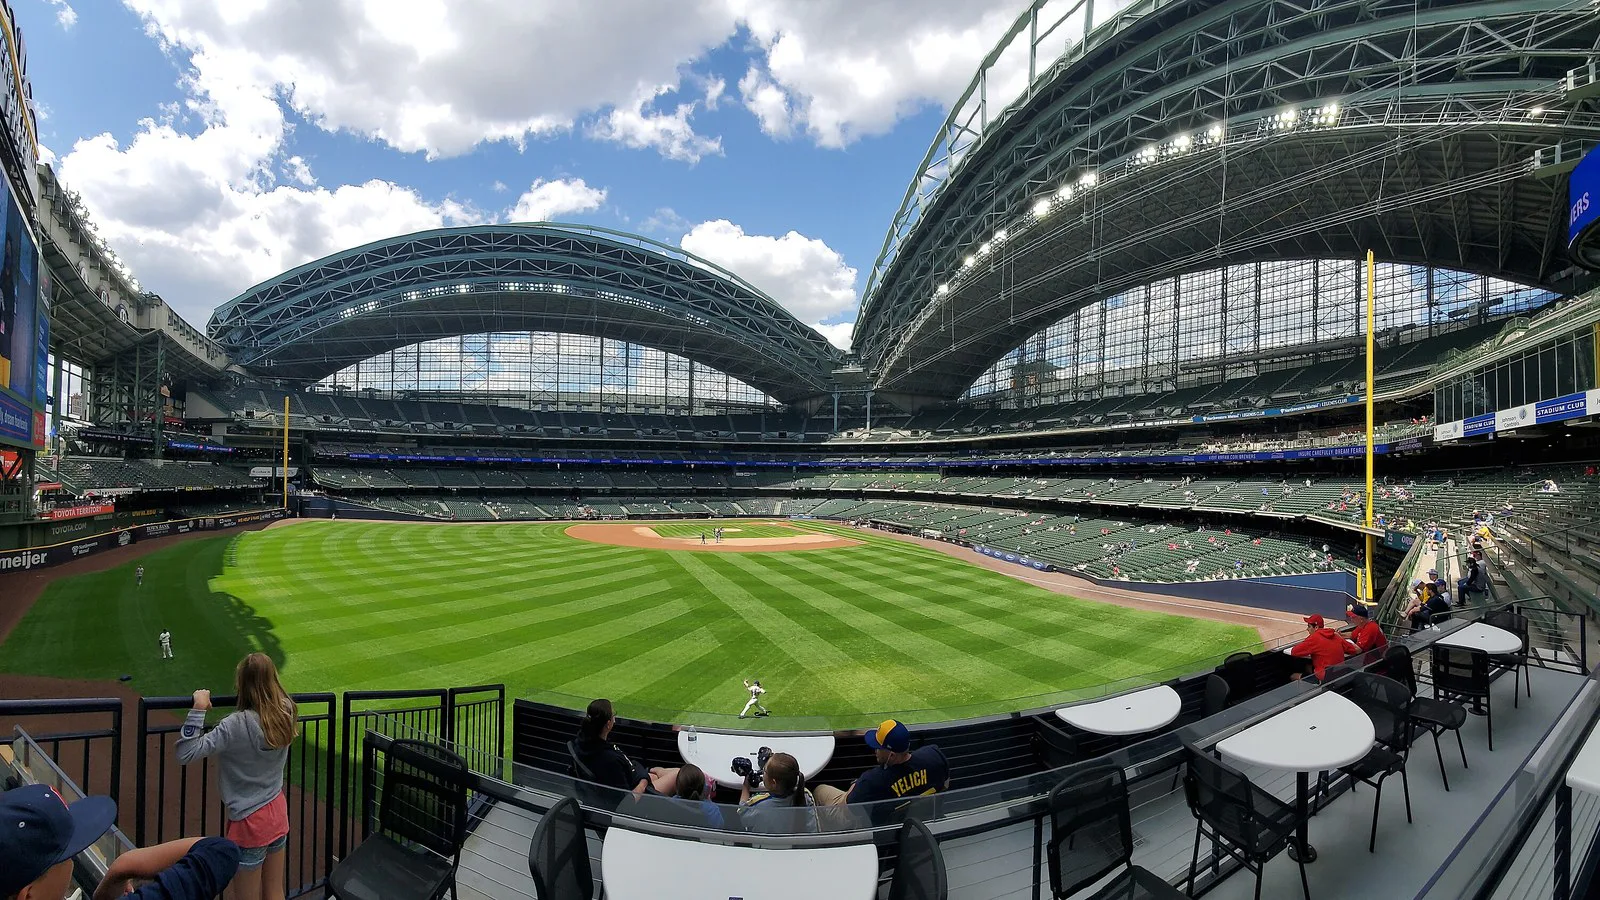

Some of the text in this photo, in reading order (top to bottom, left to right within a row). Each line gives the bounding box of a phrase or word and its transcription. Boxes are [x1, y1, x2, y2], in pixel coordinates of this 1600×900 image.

[1537, 402, 1585, 416] STADIUM CLUB
[1464, 423, 1482, 431] STADIUM
[1504, 421, 1520, 429] Controls
[53, 505, 102, 518] TOYOTA TERRITORY
[52, 522, 87, 535] TOYOTA.COM
[0, 551, 47, 569] meijer
[891, 768, 928, 797] YELICH
